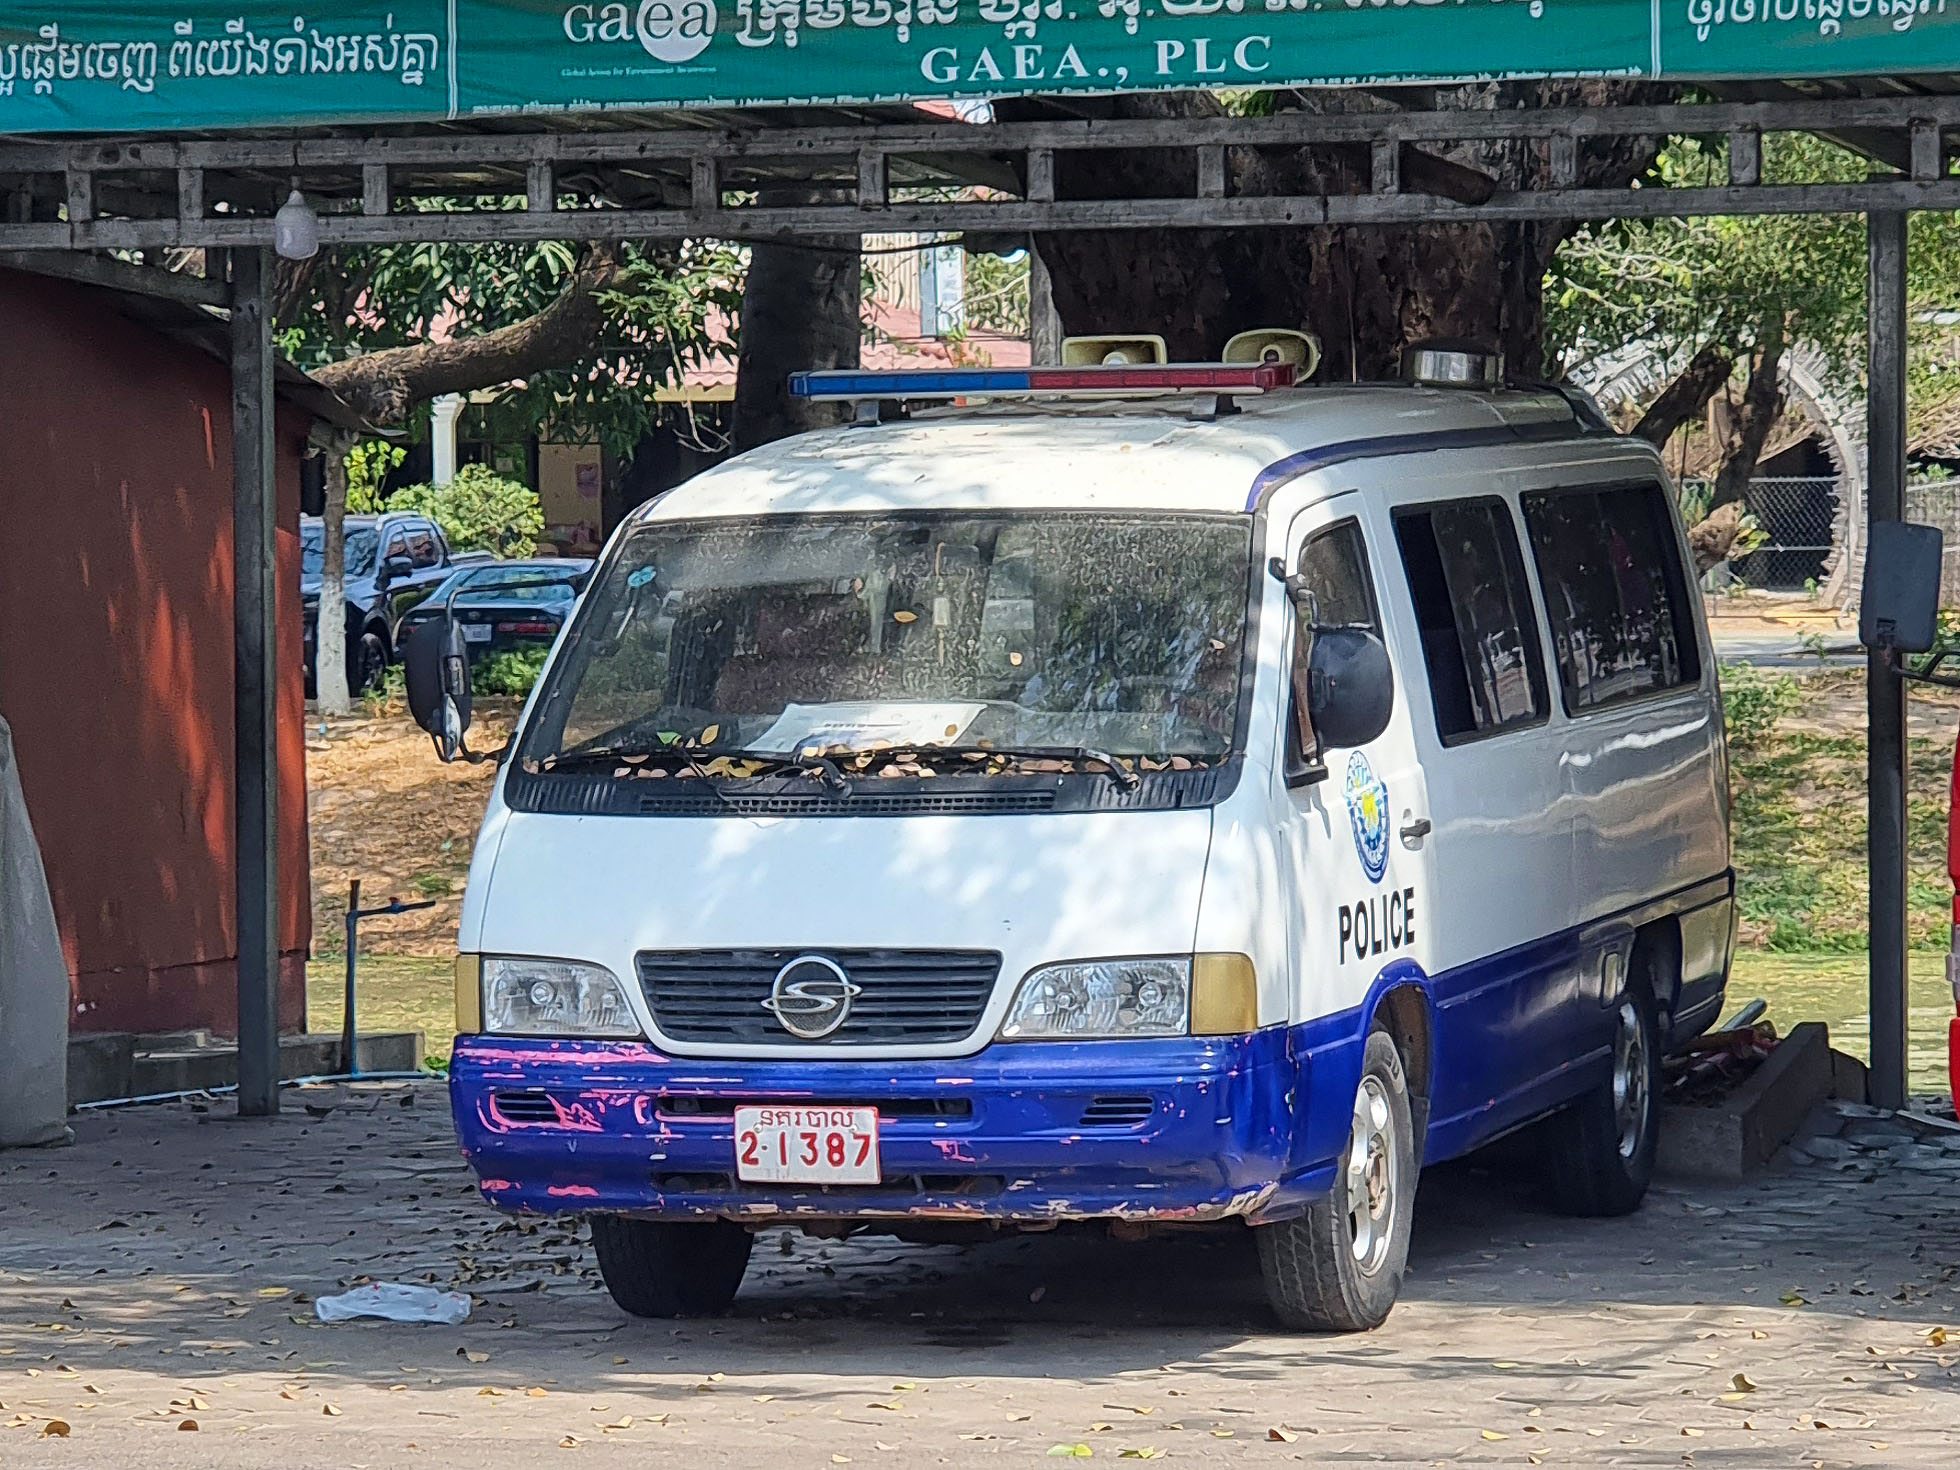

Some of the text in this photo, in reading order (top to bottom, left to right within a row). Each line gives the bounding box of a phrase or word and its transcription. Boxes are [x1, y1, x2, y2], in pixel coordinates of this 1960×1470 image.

[563, 2, 715, 43] Gaea
[1153, 35, 1272, 76] PLC
[1338, 887, 1416, 966] POLICE
[760, 1110, 855, 1128] នគរបាល
